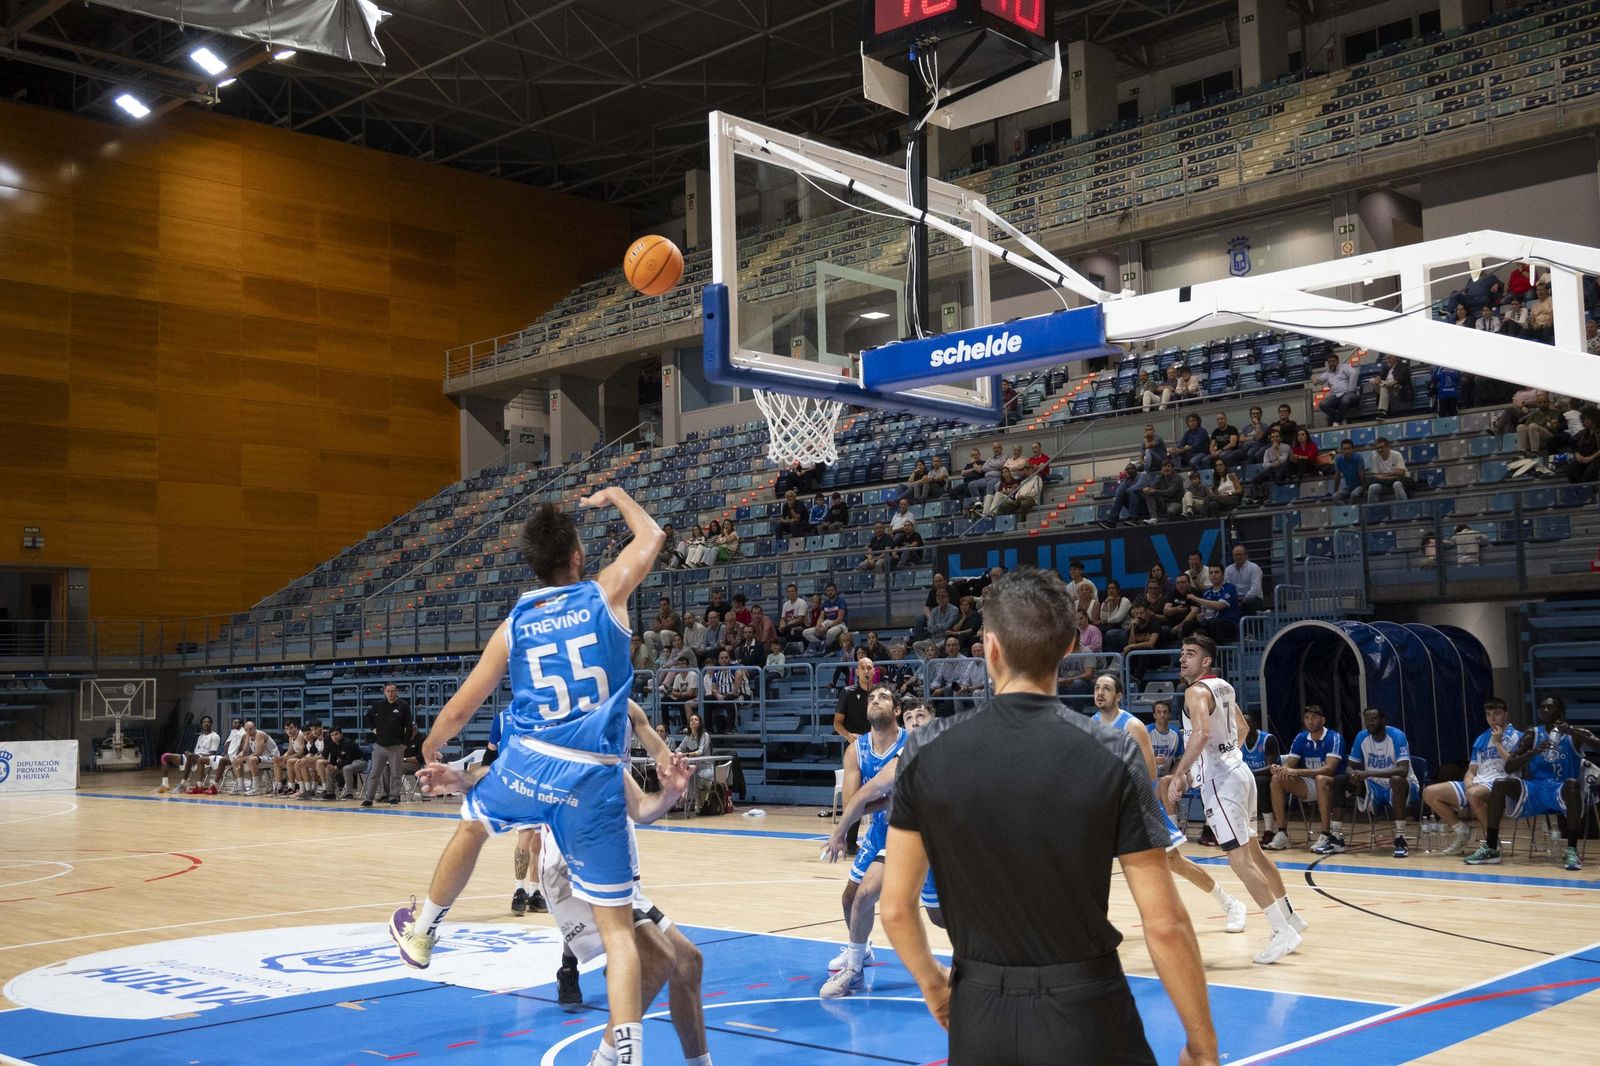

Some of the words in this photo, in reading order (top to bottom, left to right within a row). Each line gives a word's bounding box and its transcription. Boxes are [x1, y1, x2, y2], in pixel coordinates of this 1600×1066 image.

[930, 332, 1023, 368] schelde
[520, 609, 592, 637] TREVIÑO
[526, 632, 610, 720] 55
[75, 965, 272, 1005] HUELVA
